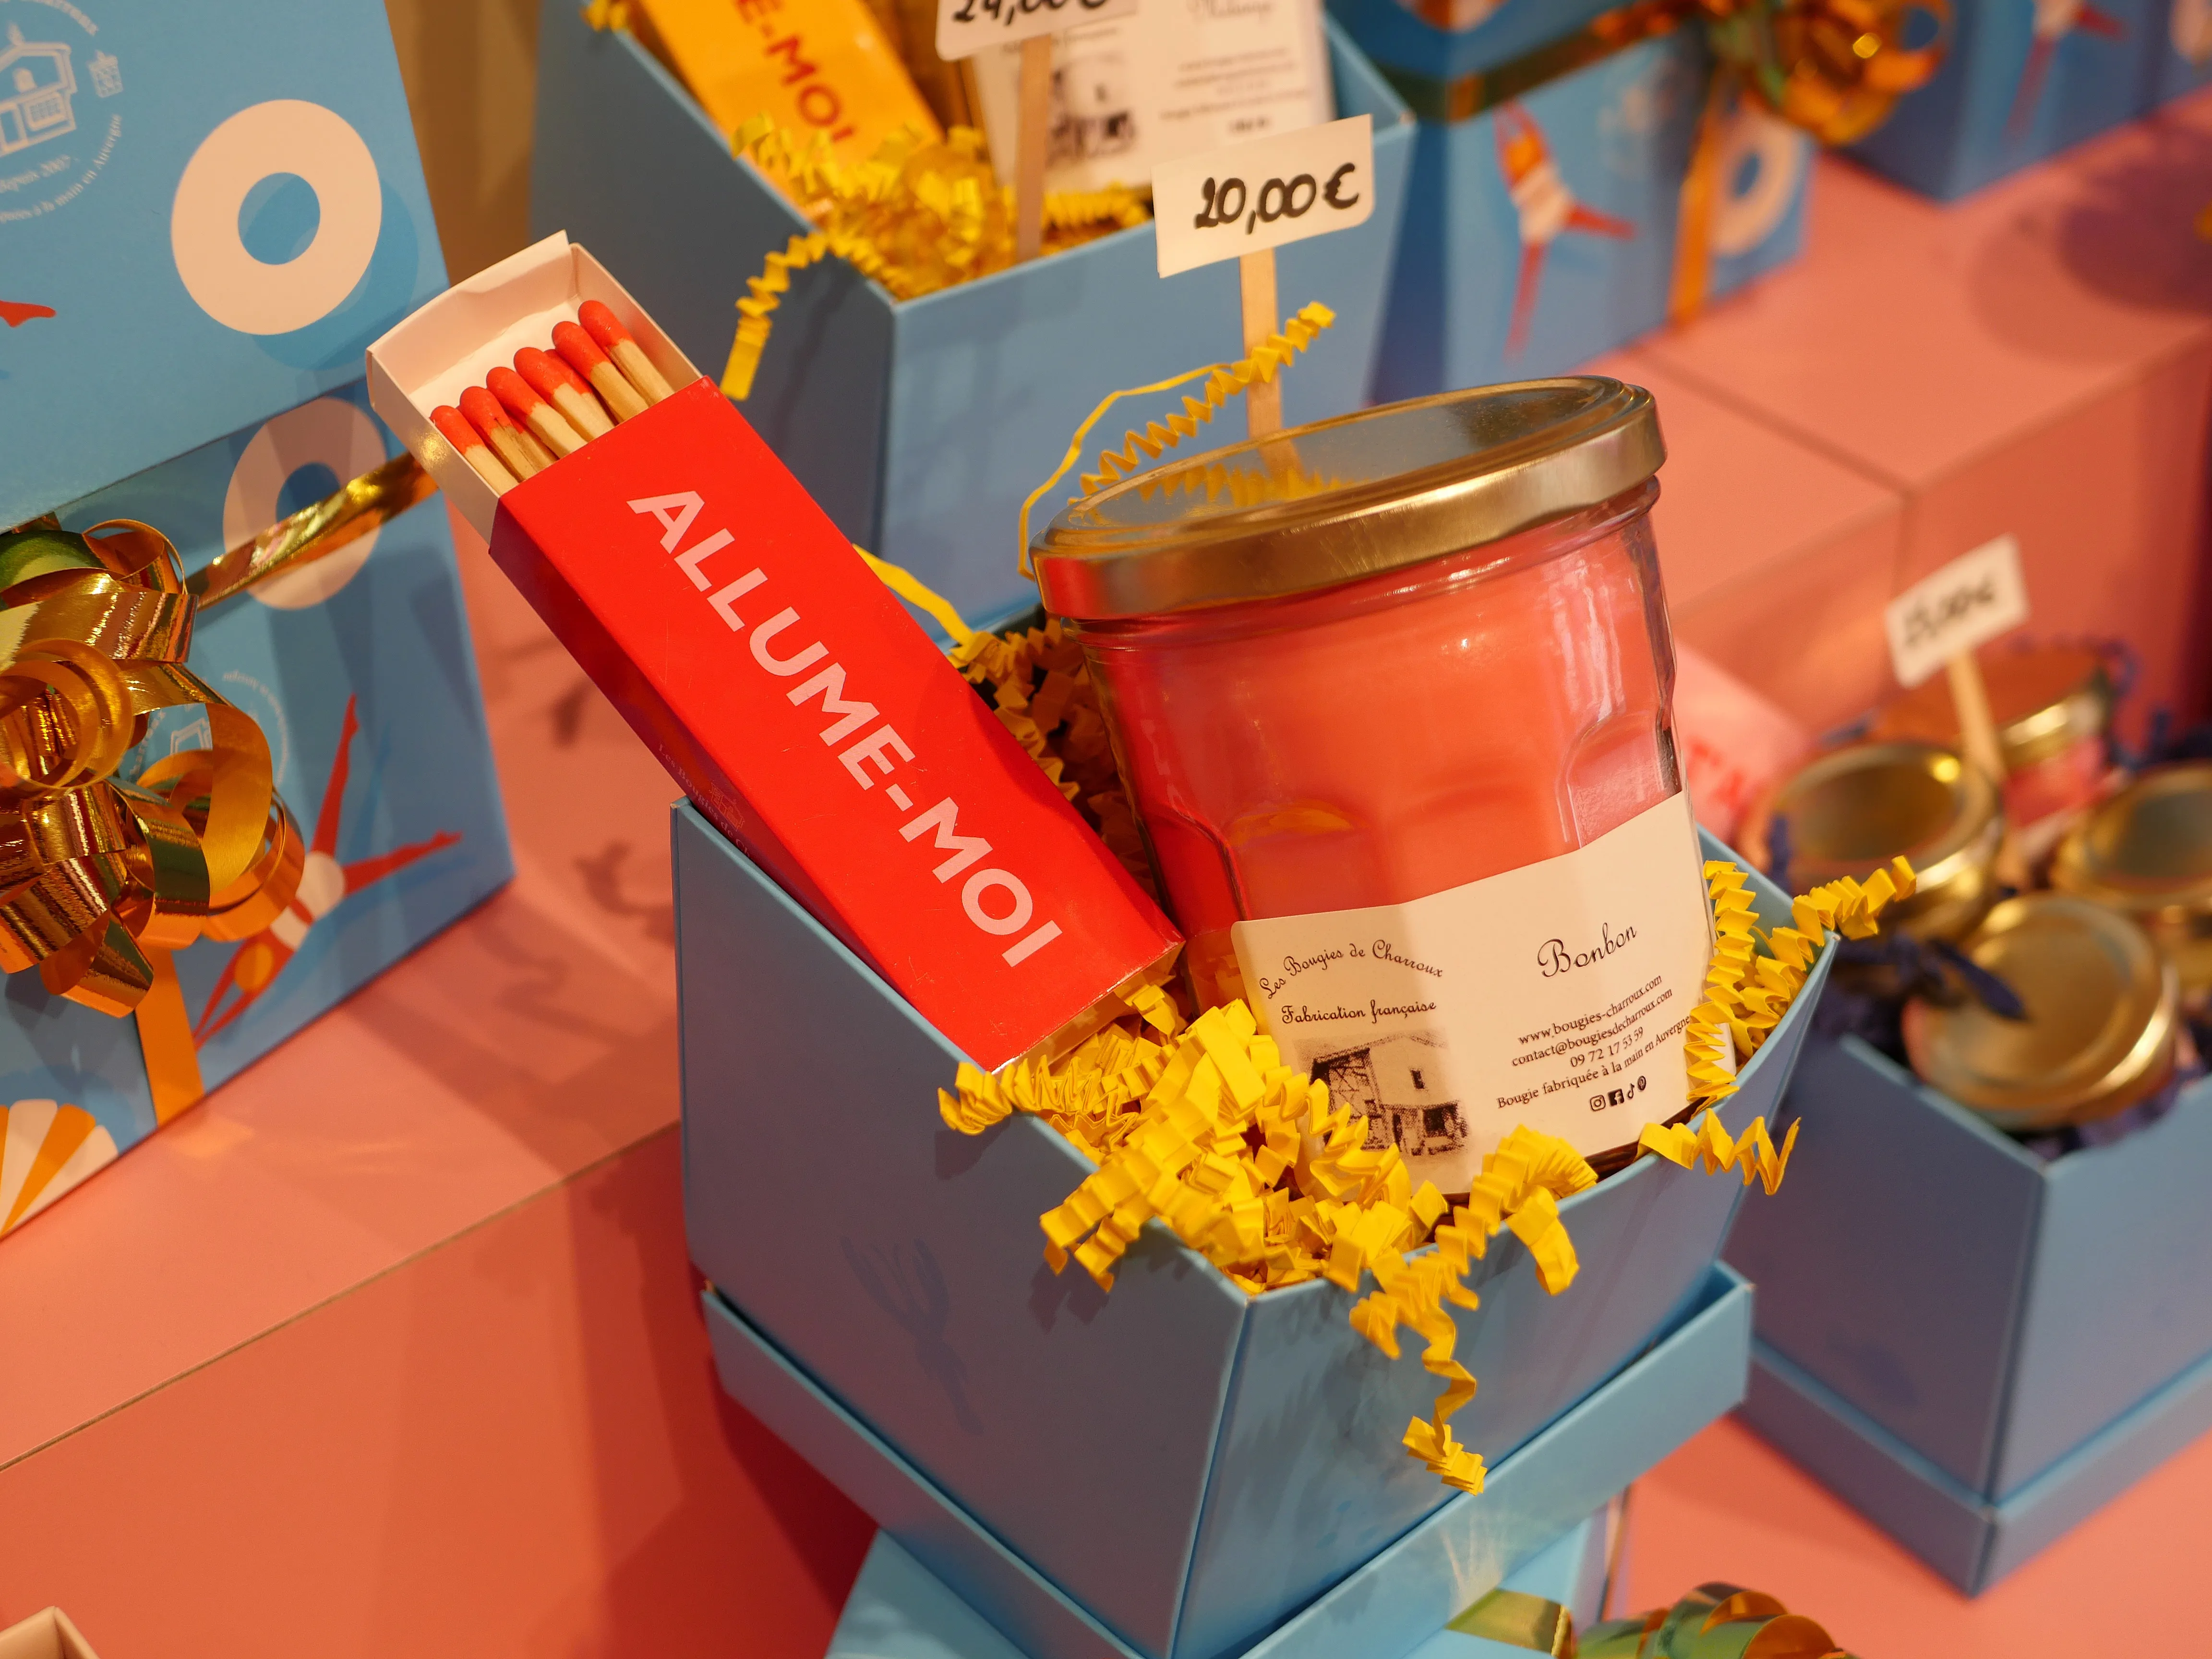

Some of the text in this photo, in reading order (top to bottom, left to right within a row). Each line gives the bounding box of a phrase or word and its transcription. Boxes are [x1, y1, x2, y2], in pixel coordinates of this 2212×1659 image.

[626, 490, 1063, 968] ALLUME-MOI
[677, 767, 719, 820] Bougies
[1259, 939, 1443, 999] Les Bougies de Charroux
[1537, 922, 1637, 977] Bonbon
[1281, 999, 1437, 1024] Fabrication française
[1512, 987, 1673, 1067] contact@bougiesdecharroux.com
[1517, 975, 1662, 1045] www.bougies-charroux.com
[1497, 1014, 1691, 1109] Bougie fabriquée à la main en Auvergne
[1570, 1026, 1644, 1068] 09 72 17 53 59
